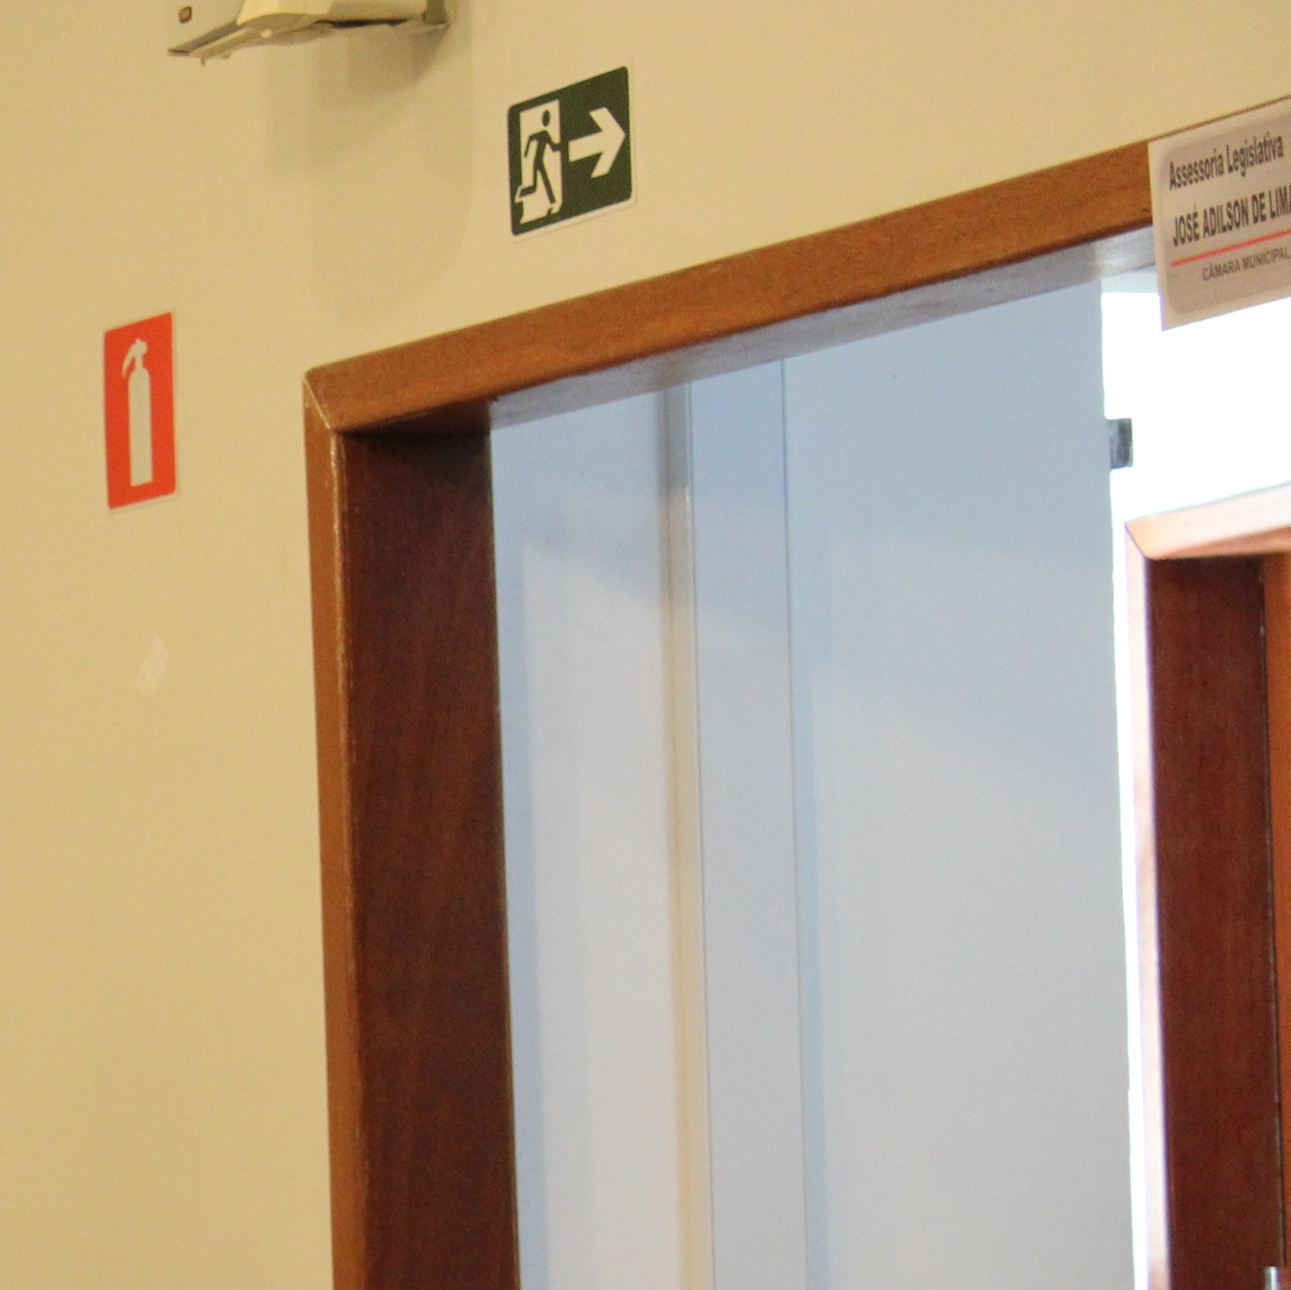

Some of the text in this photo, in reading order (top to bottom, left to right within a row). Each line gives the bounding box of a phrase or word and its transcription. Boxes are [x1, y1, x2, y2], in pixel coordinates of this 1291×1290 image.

[1169, 132, 1284, 191] Assessoria Legislativa
[1173, 204, 1200, 247] JOSÉ
[1202, 197, 1250, 239] ADILSON
[1251, 191, 1267, 224] DE
[1202, 247, 1291, 281] CÂMARA MUNICIPAL
